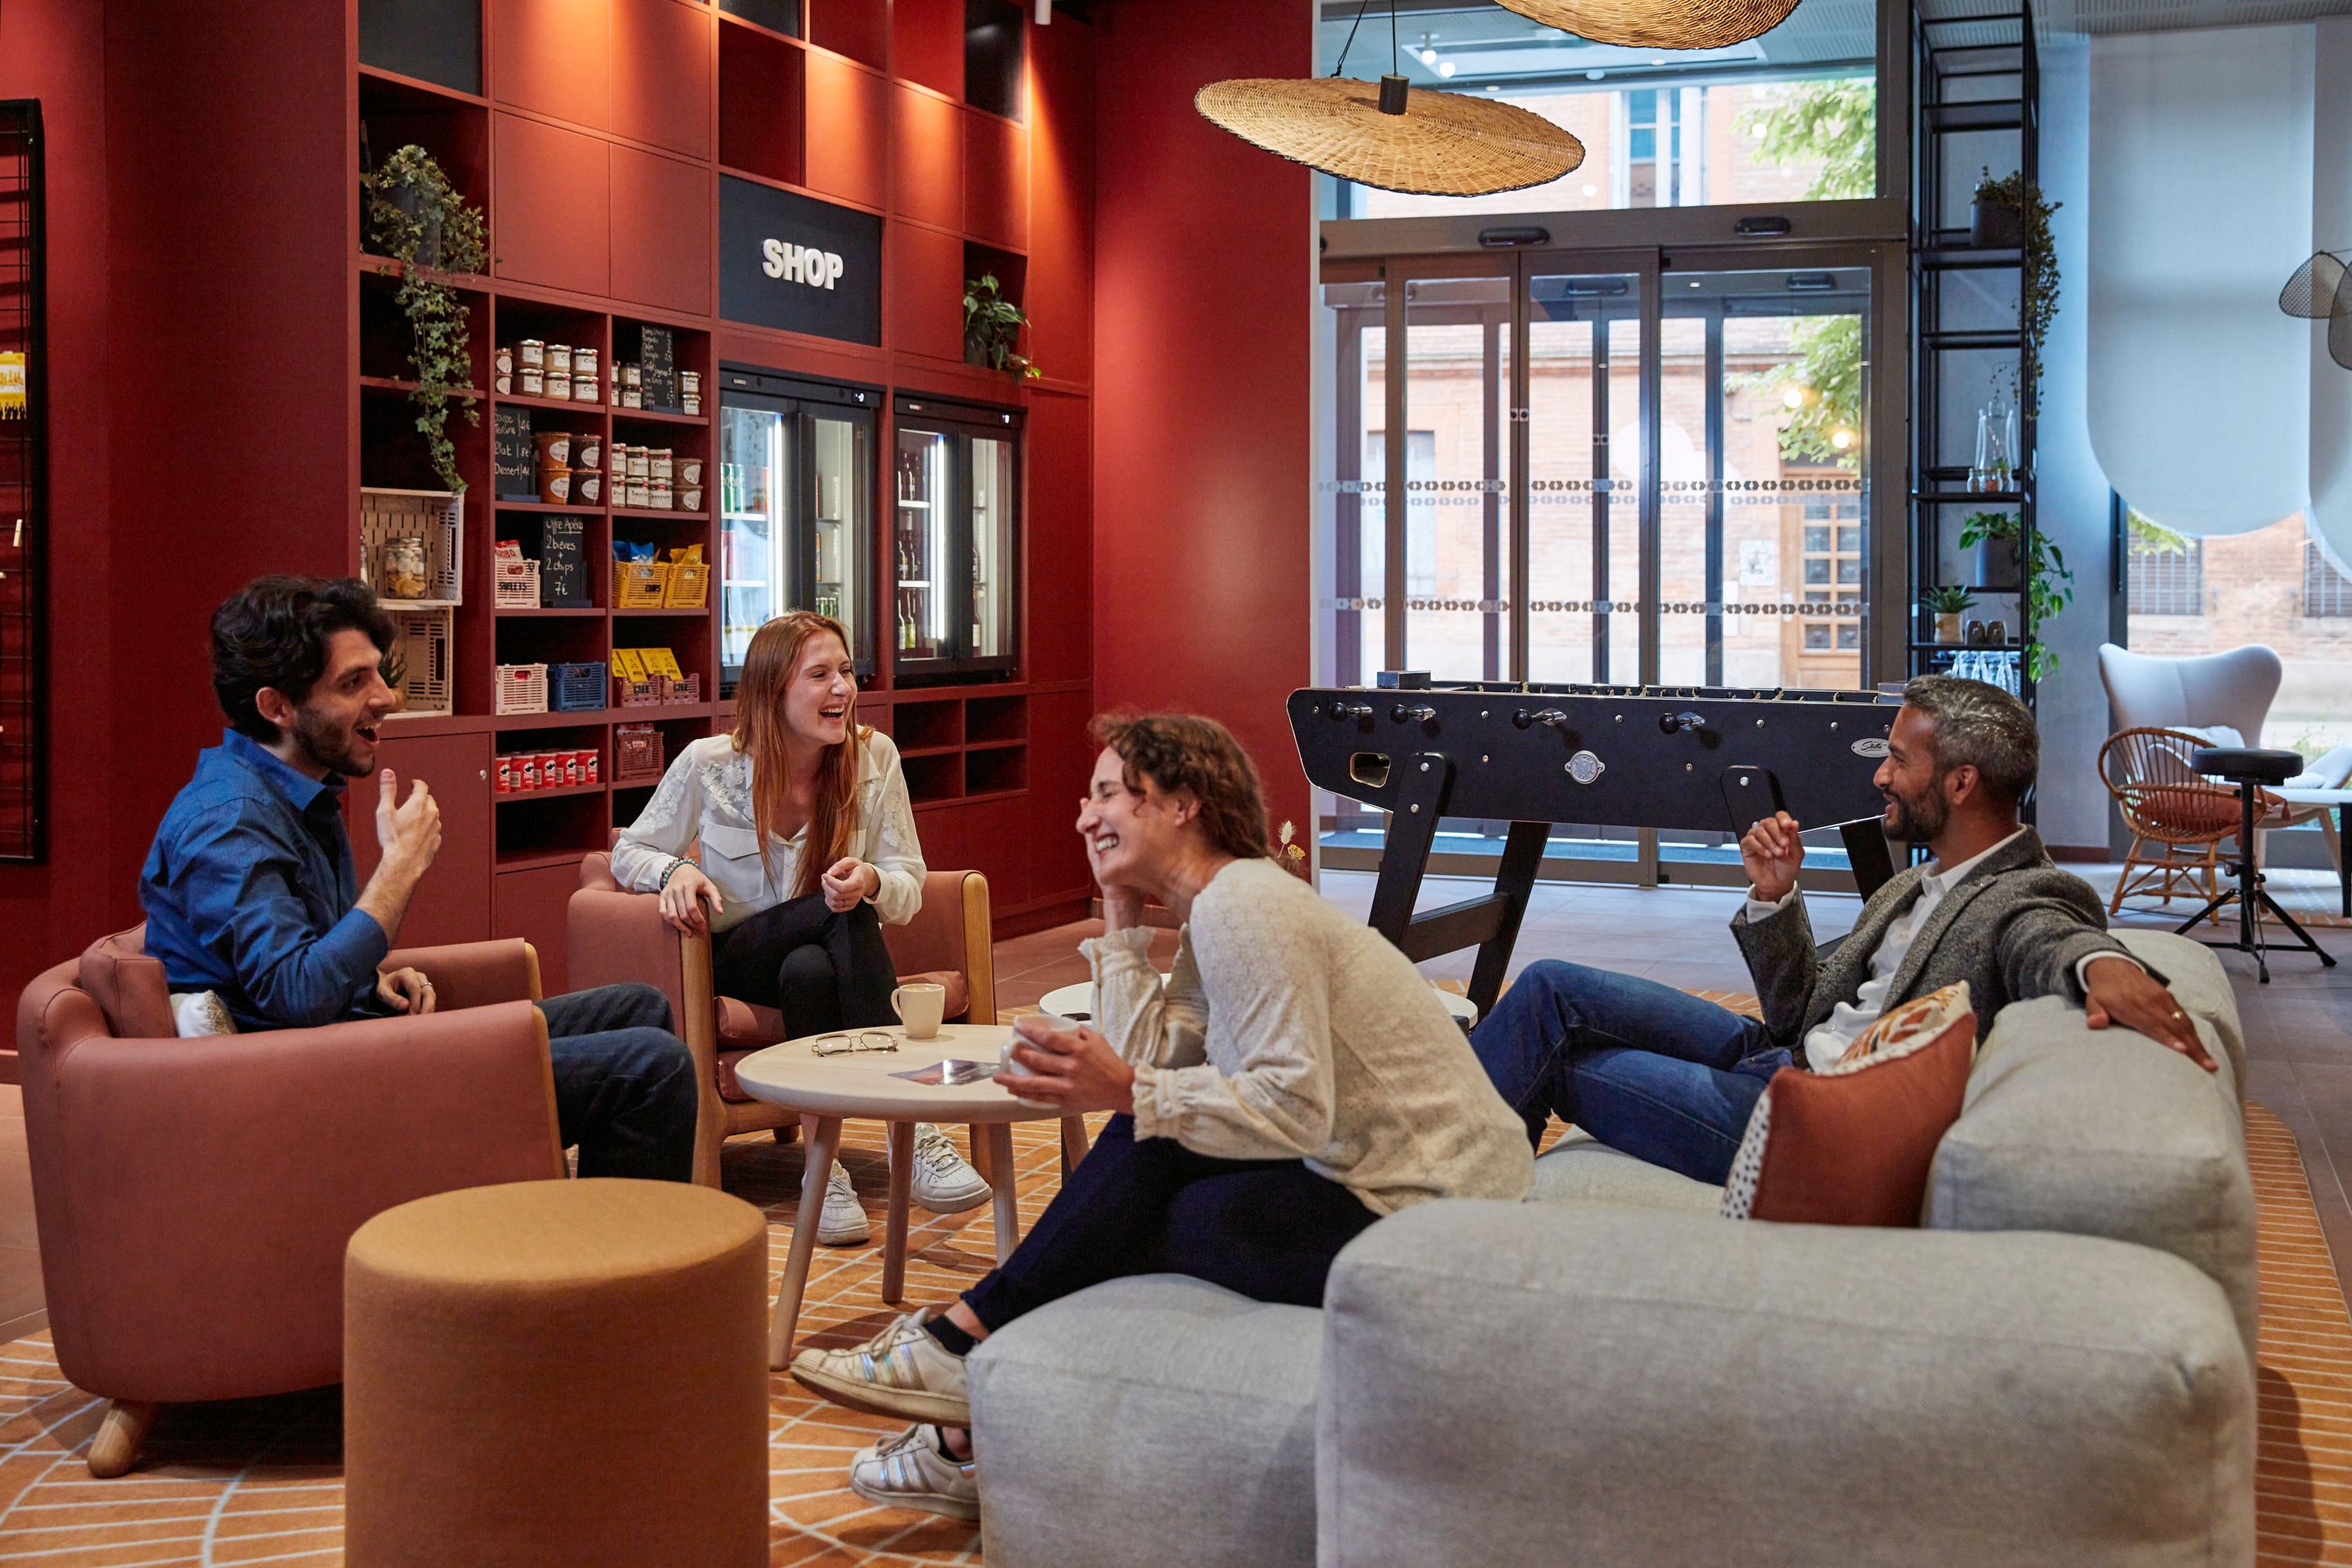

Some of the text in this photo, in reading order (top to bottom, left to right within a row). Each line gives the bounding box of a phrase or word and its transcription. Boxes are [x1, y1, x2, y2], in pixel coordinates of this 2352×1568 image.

[763, 238, 844, 290] SHOP
[546, 535, 552, 549] 2
[546, 557, 574, 575] 2 chips
[554, 582, 568, 596] 7€
